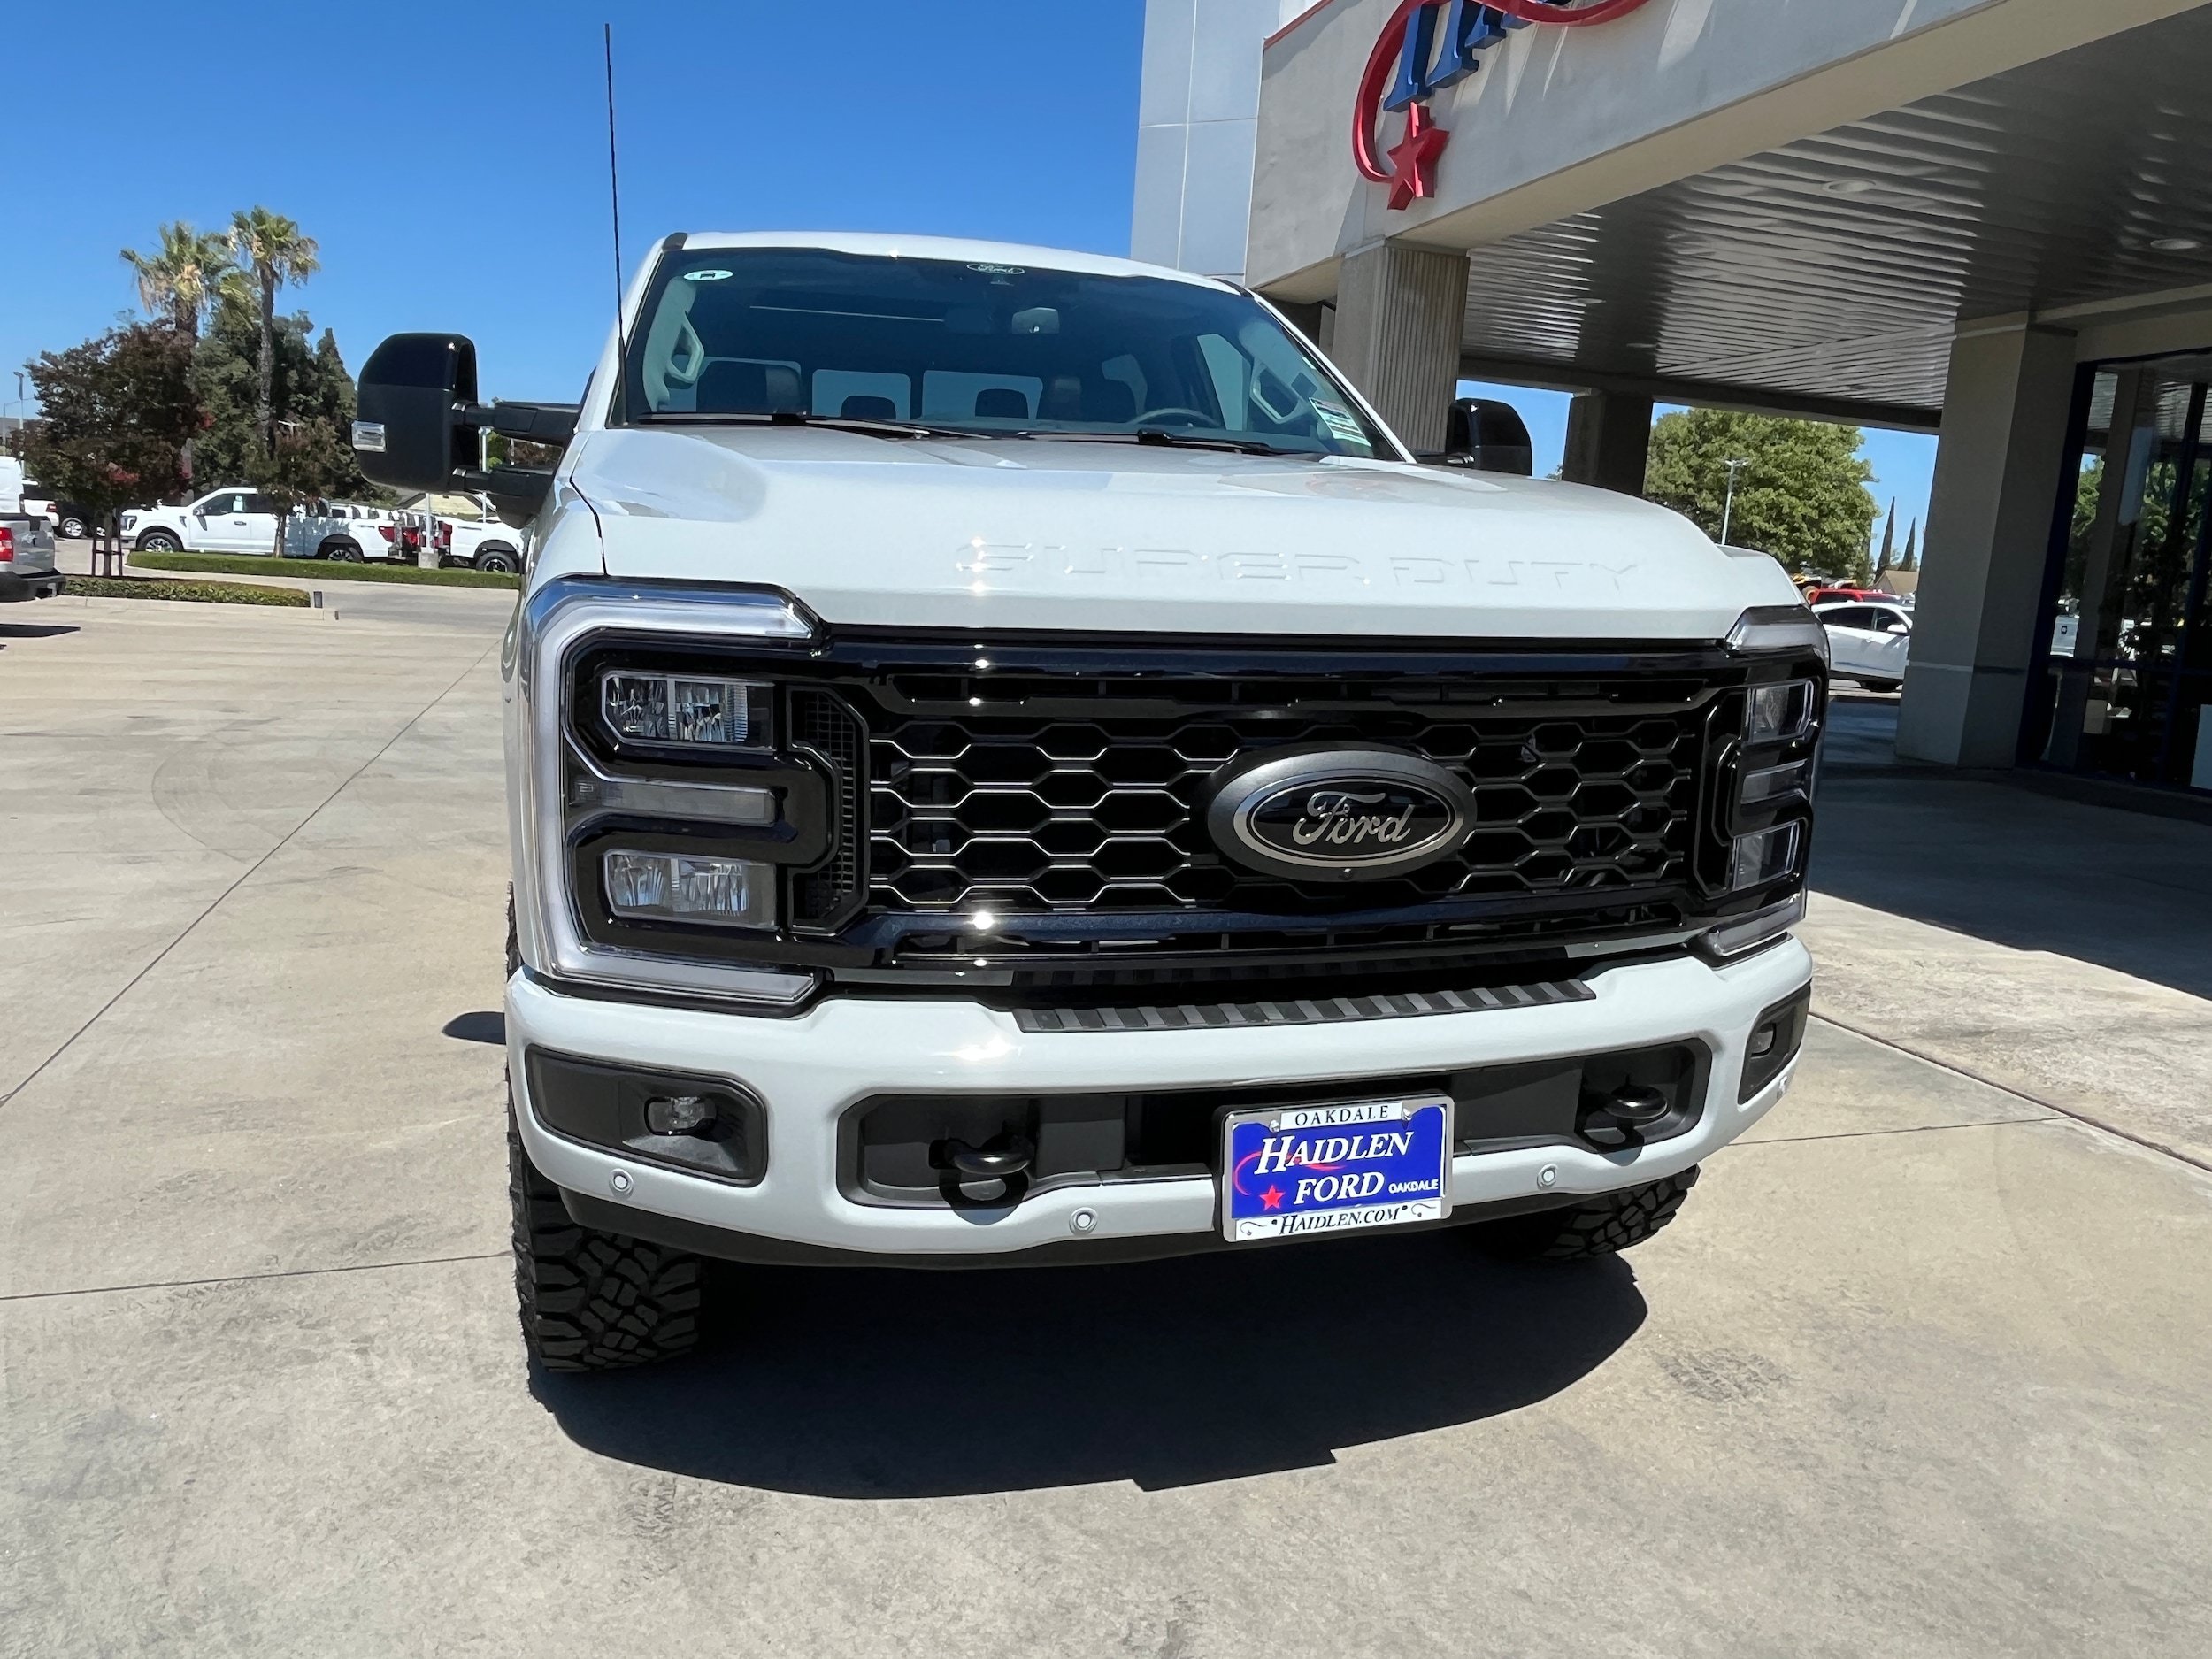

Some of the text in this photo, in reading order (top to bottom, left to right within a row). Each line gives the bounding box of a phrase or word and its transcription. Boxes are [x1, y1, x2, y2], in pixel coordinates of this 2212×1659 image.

[956, 541, 1638, 591] SUPER DUTY
[1292, 790, 1416, 845] Ford
[1294, 1105, 1390, 1127] OAKDALE
[1254, 1131, 1415, 1176] HAIDLEN
[1293, 1171, 1440, 1206] FORD OAKDALE
[1279, 1205, 1400, 1236] HAIDLEN.COM
